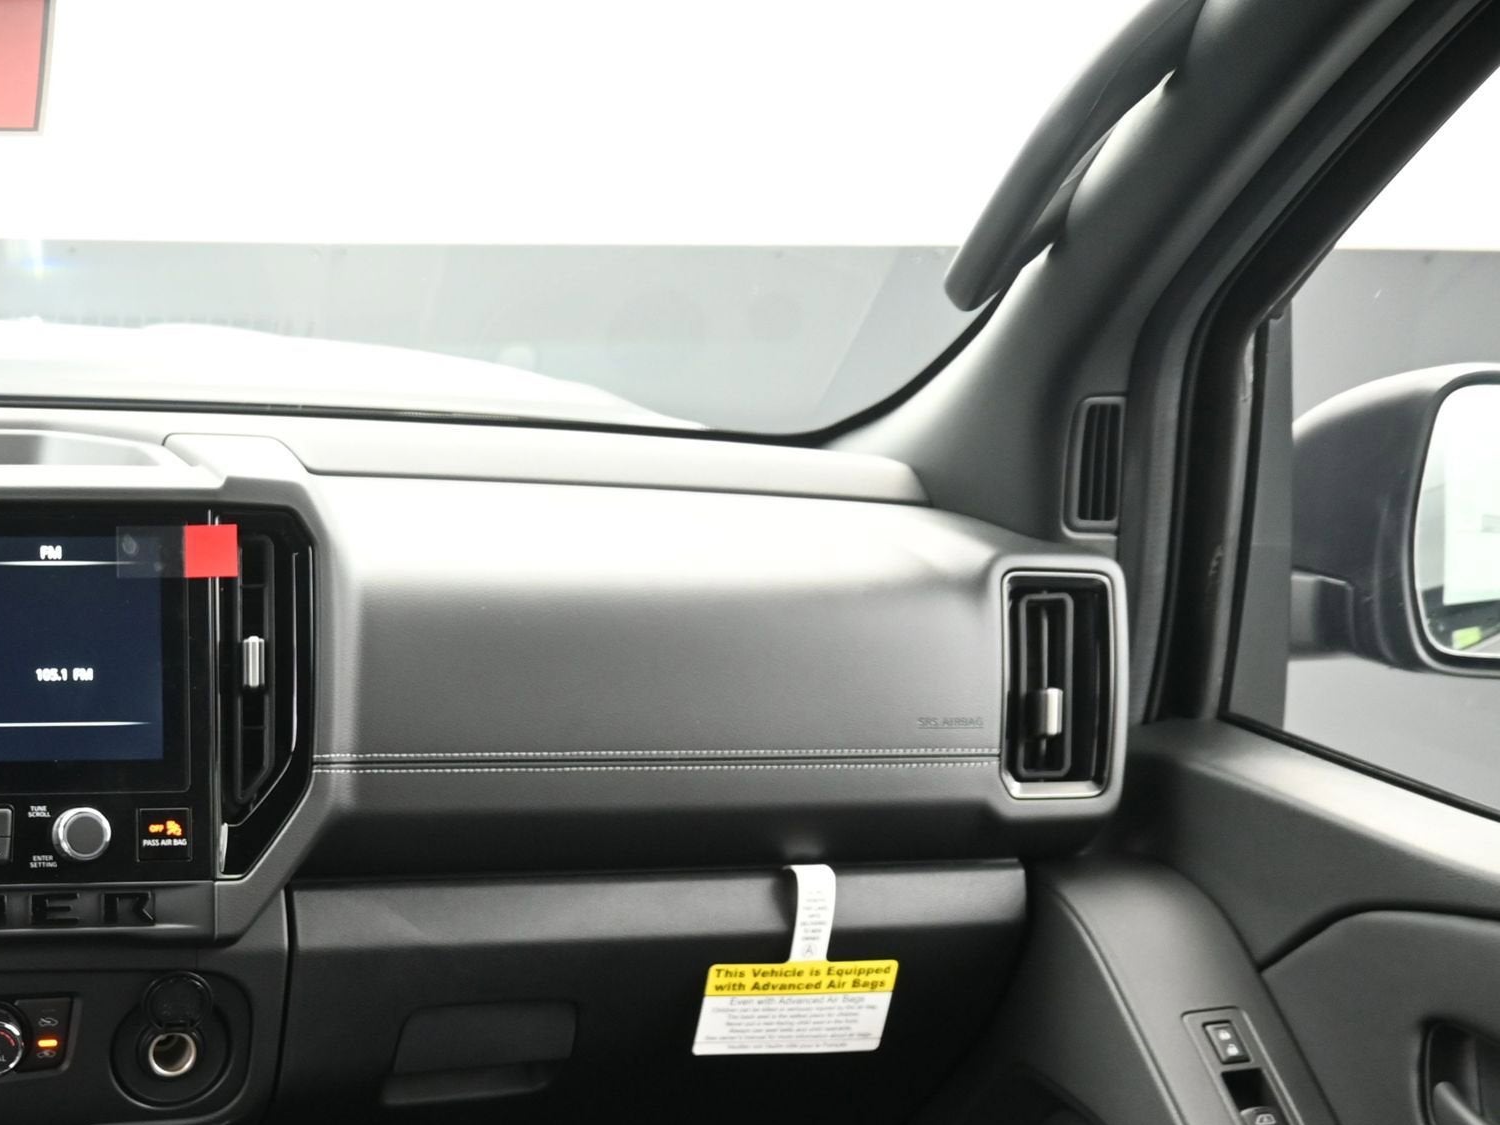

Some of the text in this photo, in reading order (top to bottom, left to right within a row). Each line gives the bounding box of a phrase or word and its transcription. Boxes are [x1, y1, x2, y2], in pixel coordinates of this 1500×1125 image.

[40, 545, 62, 560] FM
[73, 668, 94, 681] FM
[142, 839, 160, 847] PASS
[173, 838, 188, 846] BAG
[30, 861, 58, 869] SETTING
[715, 966, 891, 979] This Vehicle is Equipped
[714, 979, 886, 992] with Advanced Air Bags
